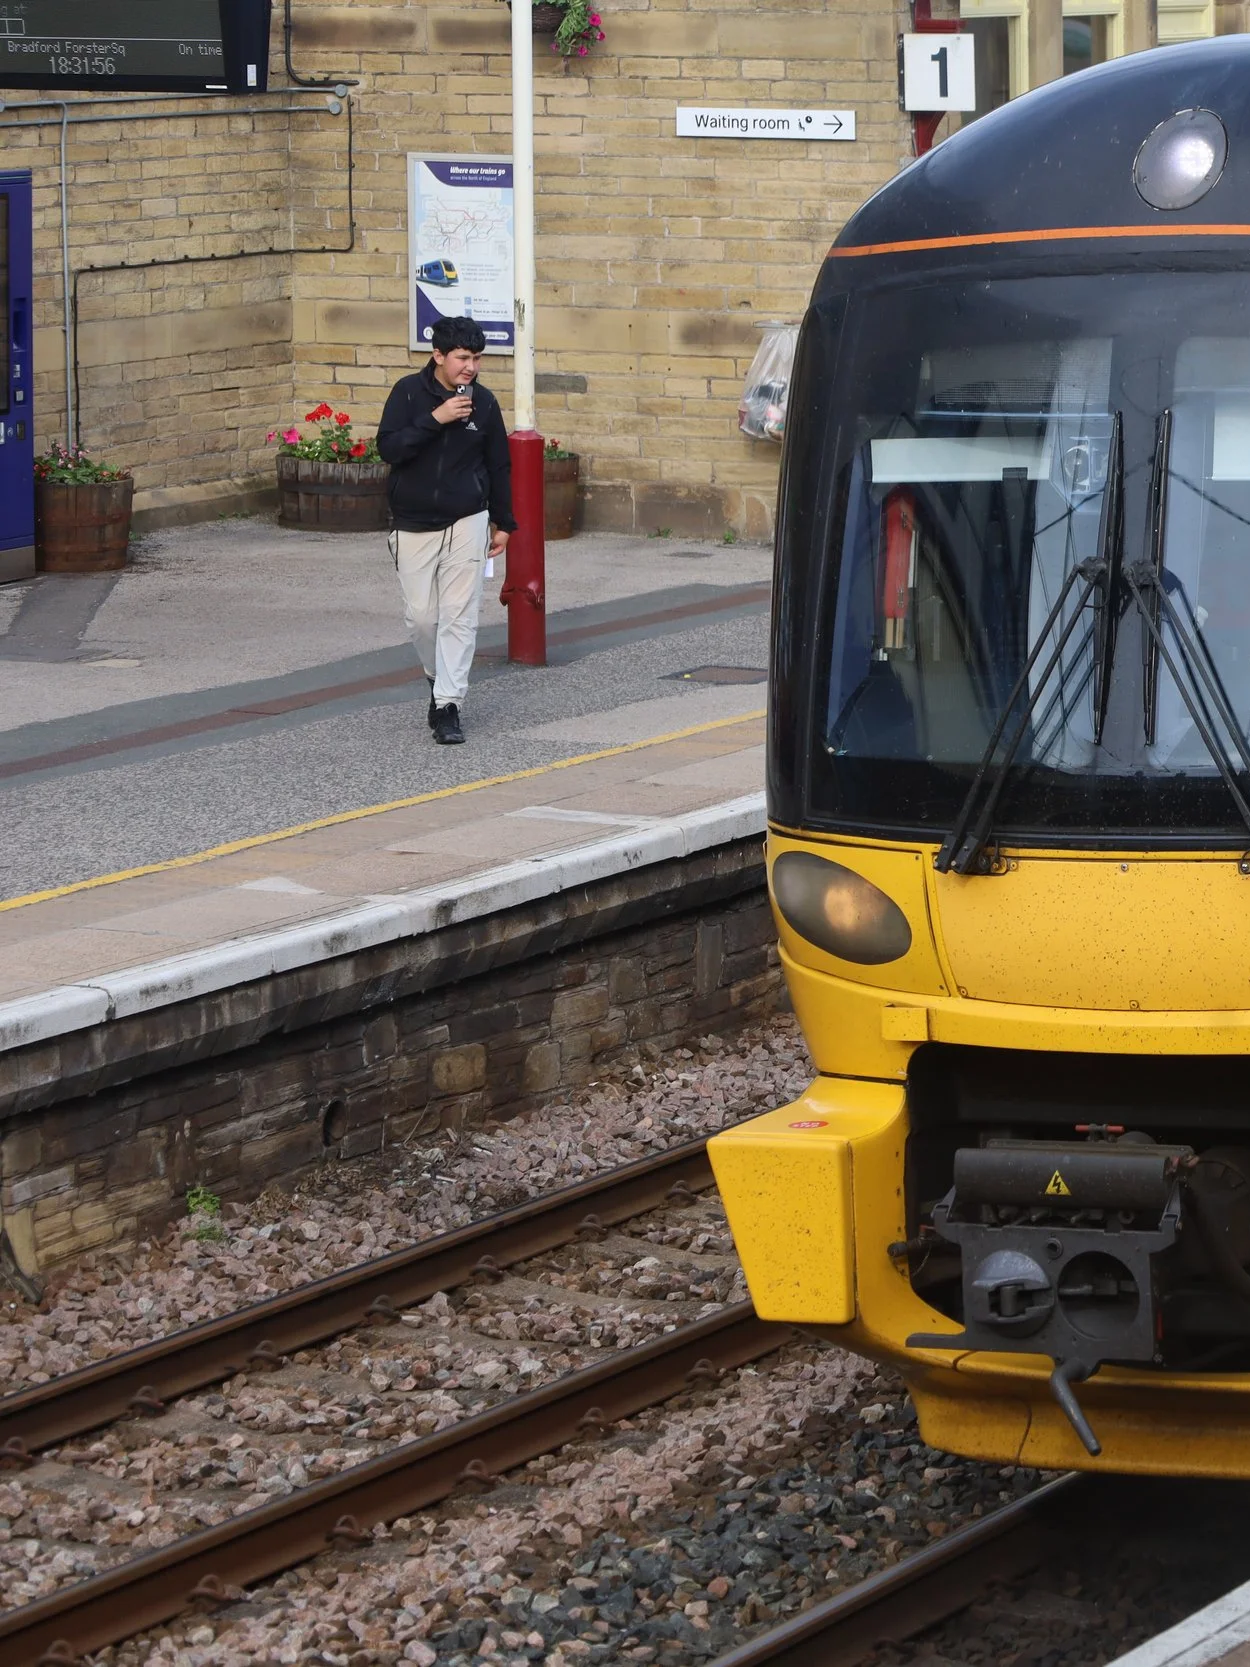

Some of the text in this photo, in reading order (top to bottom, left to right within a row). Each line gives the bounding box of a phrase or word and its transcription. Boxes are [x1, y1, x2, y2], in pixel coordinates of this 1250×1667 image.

[7, 40, 223, 57] Bradford ForsterSq On time
[49, 56, 116, 75] 18:31:56
[930, 46, 949, 97] 1
[695, 114, 790, 132] Waiting room
[450, 166, 469, 174] Where
[480, 167, 497, 175] trains
[497, 168, 506, 176] go
